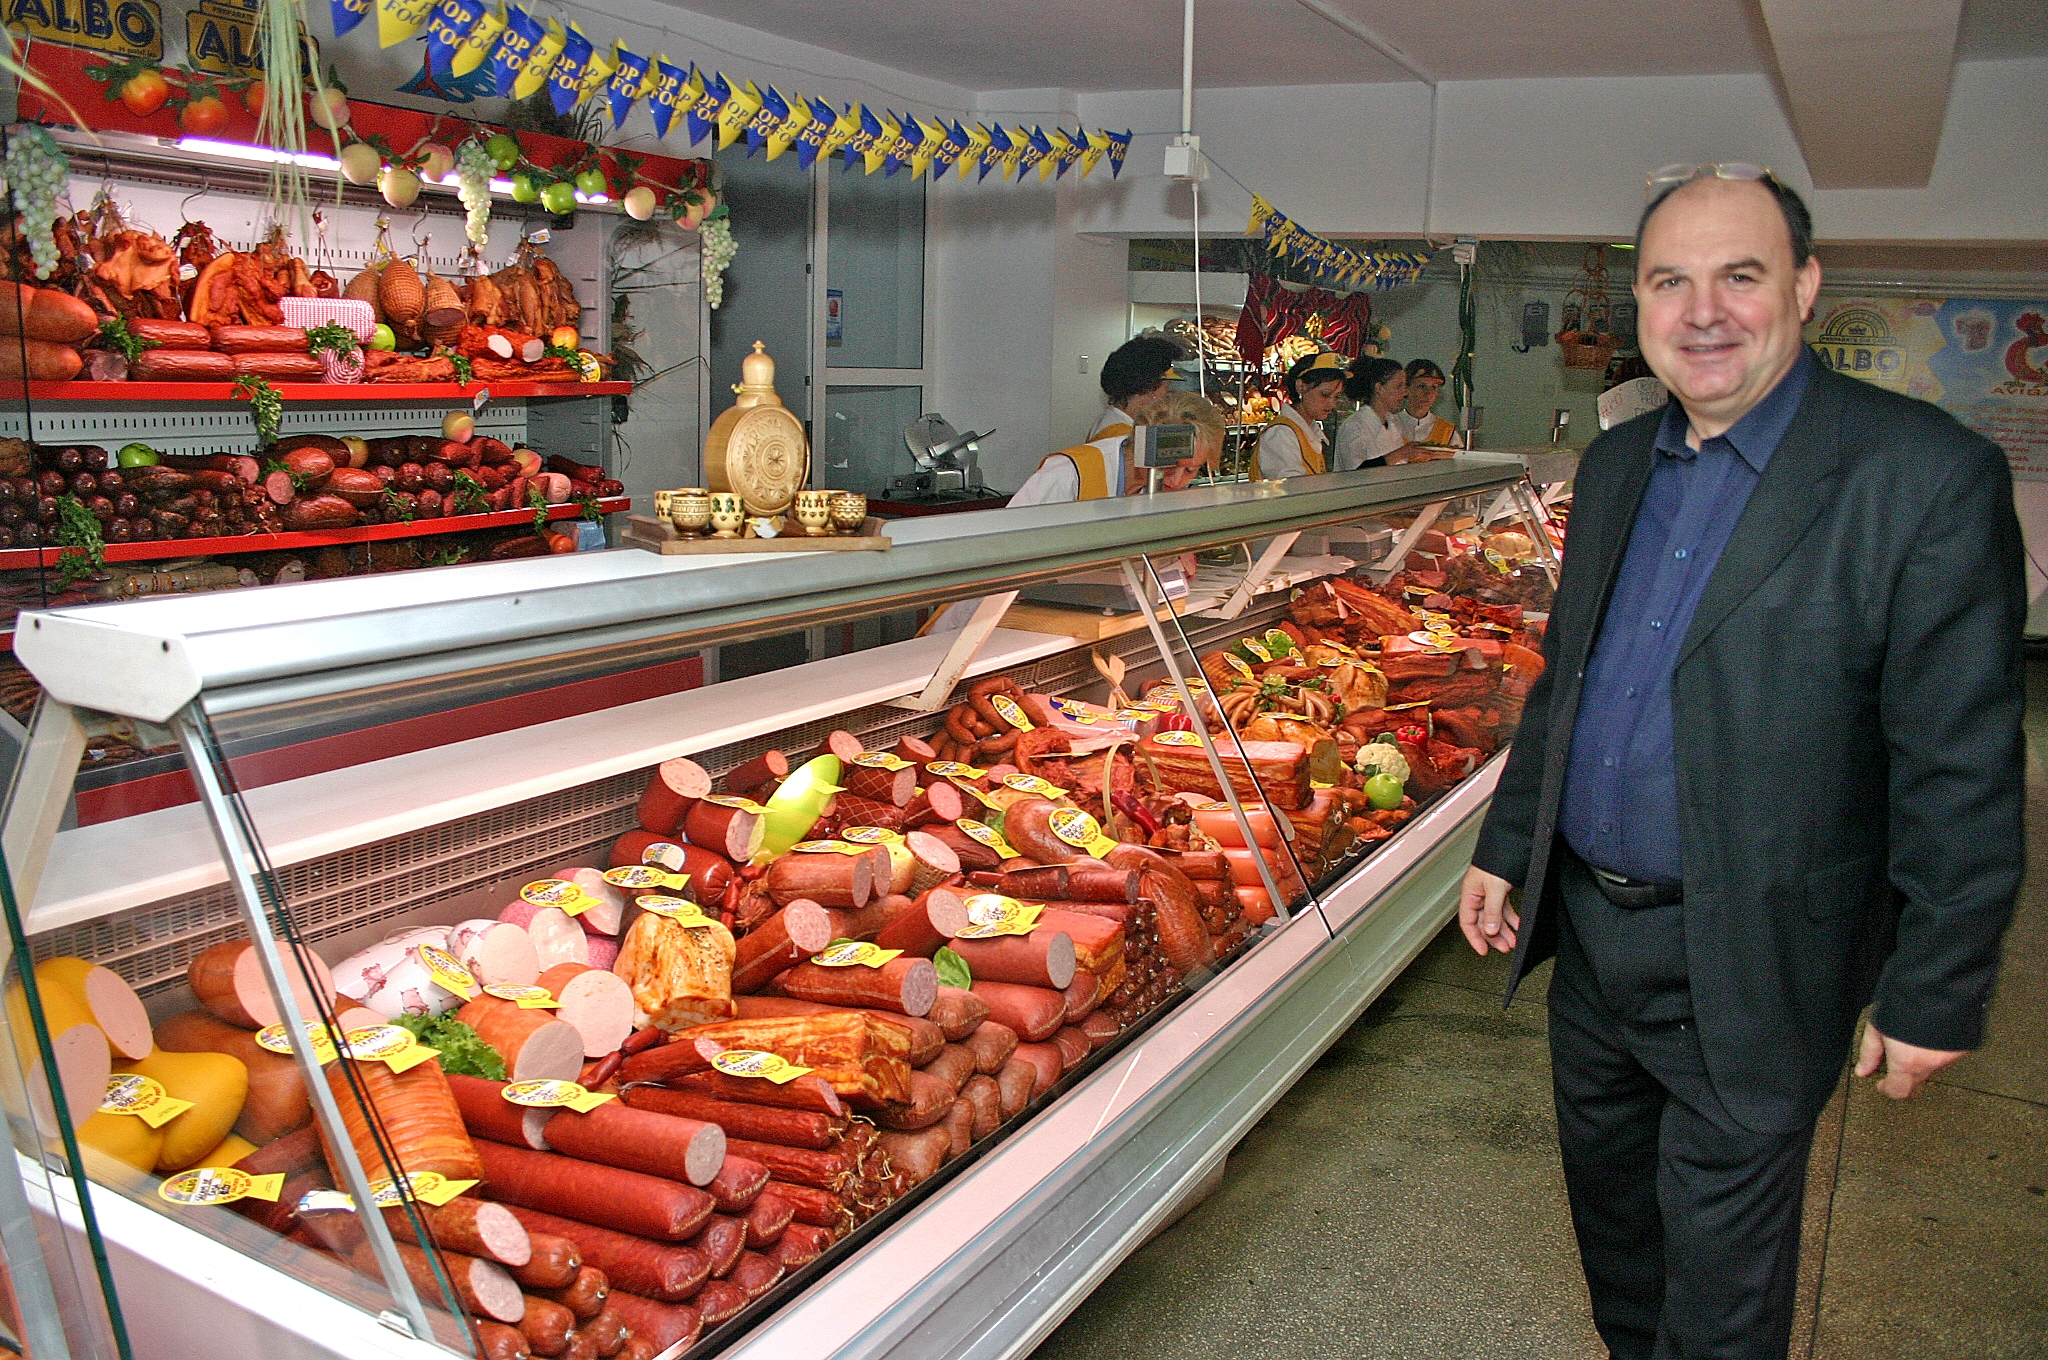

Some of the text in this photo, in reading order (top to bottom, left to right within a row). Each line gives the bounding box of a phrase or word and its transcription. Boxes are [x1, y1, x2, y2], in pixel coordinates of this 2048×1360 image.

[10, 0, 155, 47] ALBO
[503, 29, 530, 52] OP
[616, 62, 640, 81] OP
[728, 101, 748, 118] OP
[759, 108, 780, 127] OP
[807, 118, 826, 133] OP
[894, 136, 914, 152] OP
[942, 139, 961, 155] OP
[986, 146, 1004, 159] OP
[1027, 146, 1043, 159] OP
[1817, 347, 1900, 373] ALBO
